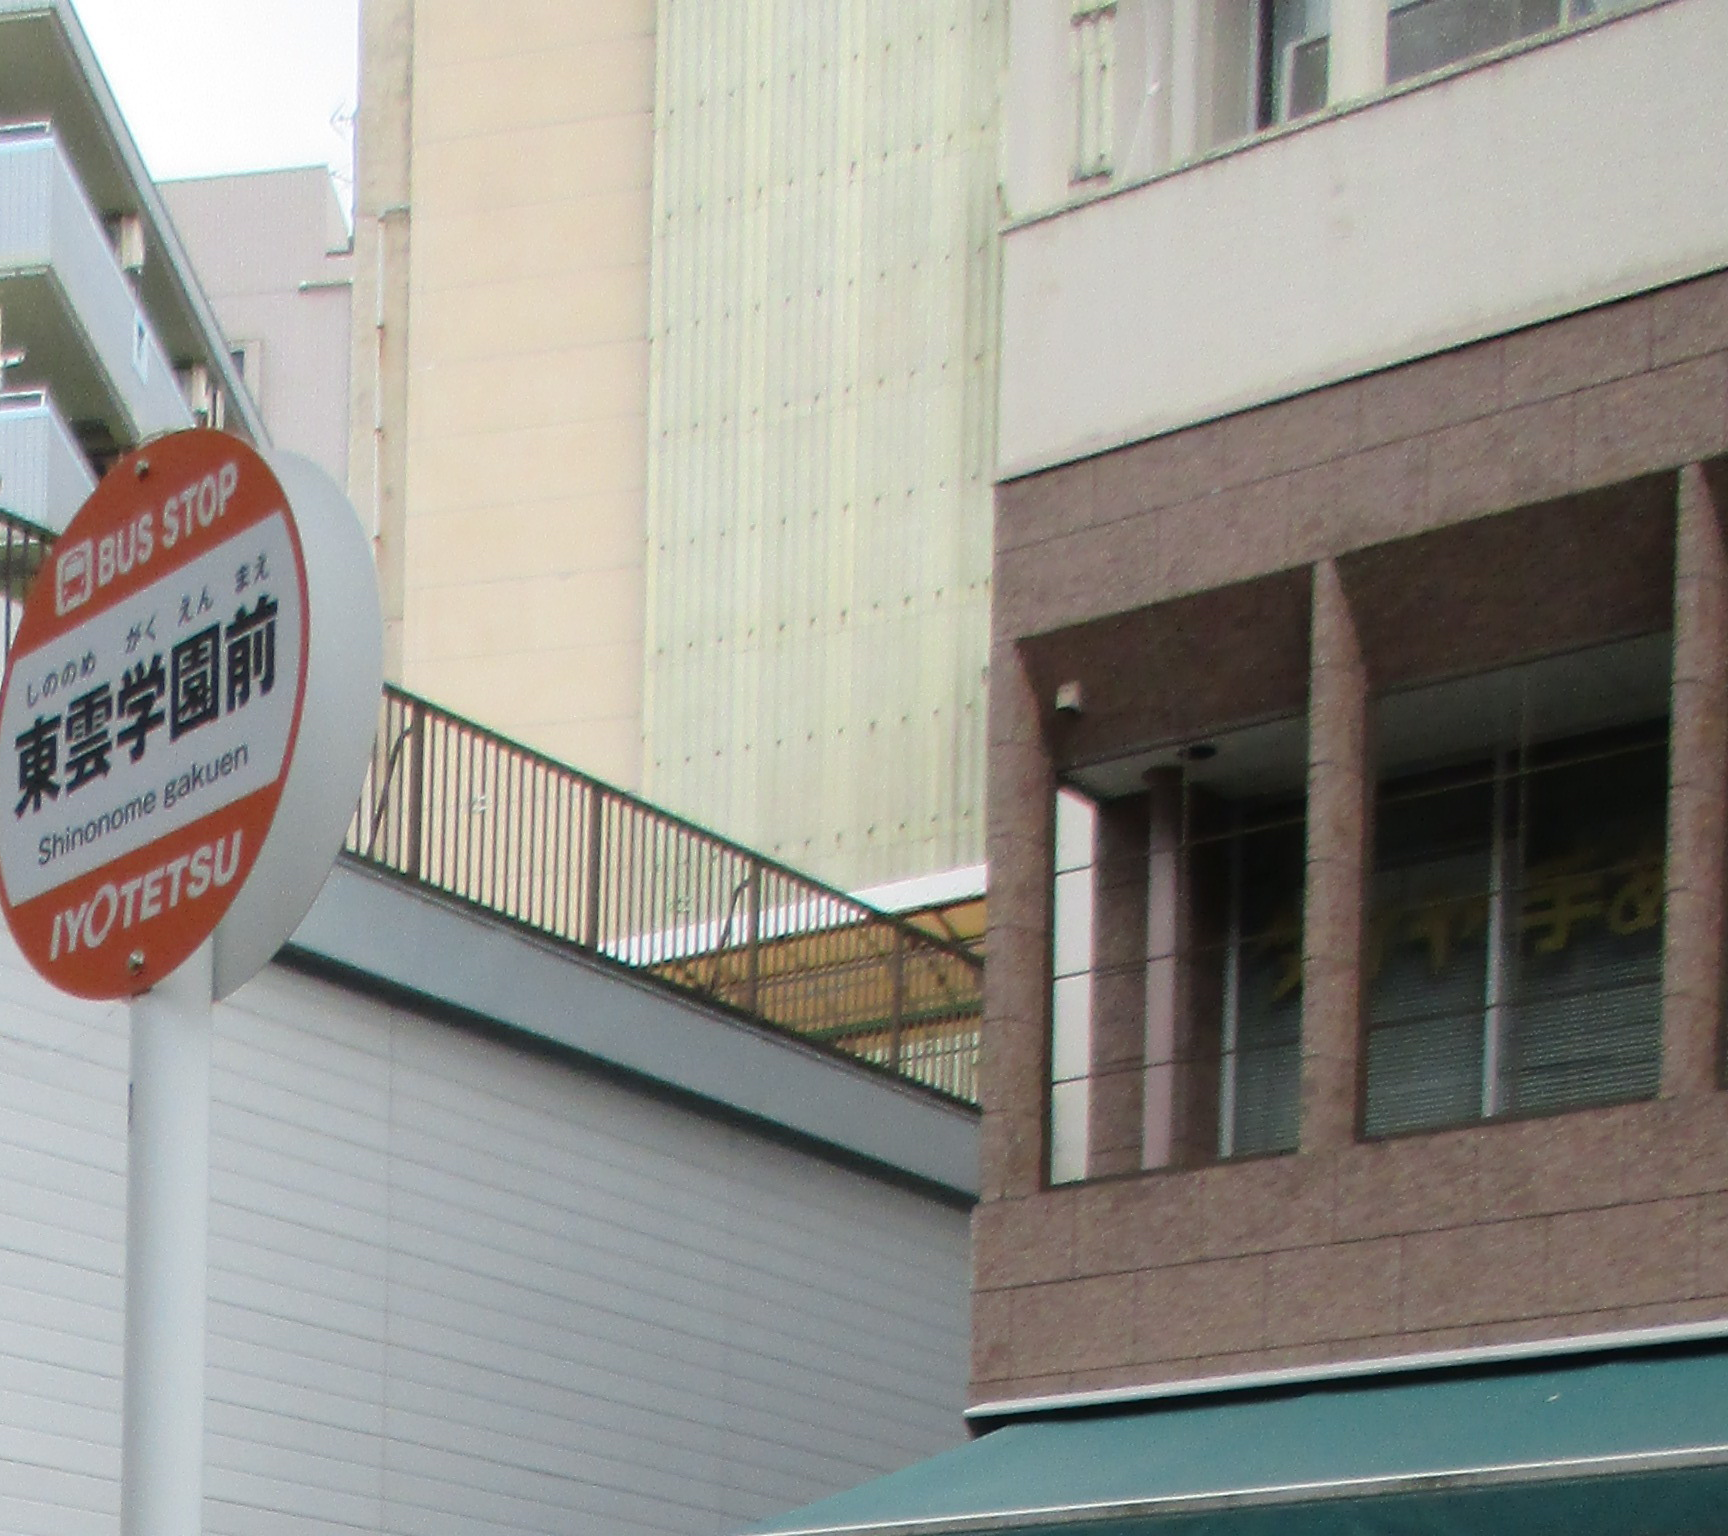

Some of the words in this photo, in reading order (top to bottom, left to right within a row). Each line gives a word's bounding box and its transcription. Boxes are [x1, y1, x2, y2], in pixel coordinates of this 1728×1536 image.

[95, 528, 152, 588] BUS
[163, 462, 238, 550] STOP
[26, 655, 96, 708] しののめ
[125, 616, 157, 654] がく
[177, 589, 212, 627] えん
[233, 553, 270, 594] まえ
[14, 595, 278, 818] 東雲学園前
[38, 791, 157, 865] Shinonome
[163, 743, 249, 806] gakuen
[49, 830, 243, 961] IYOTETSU
